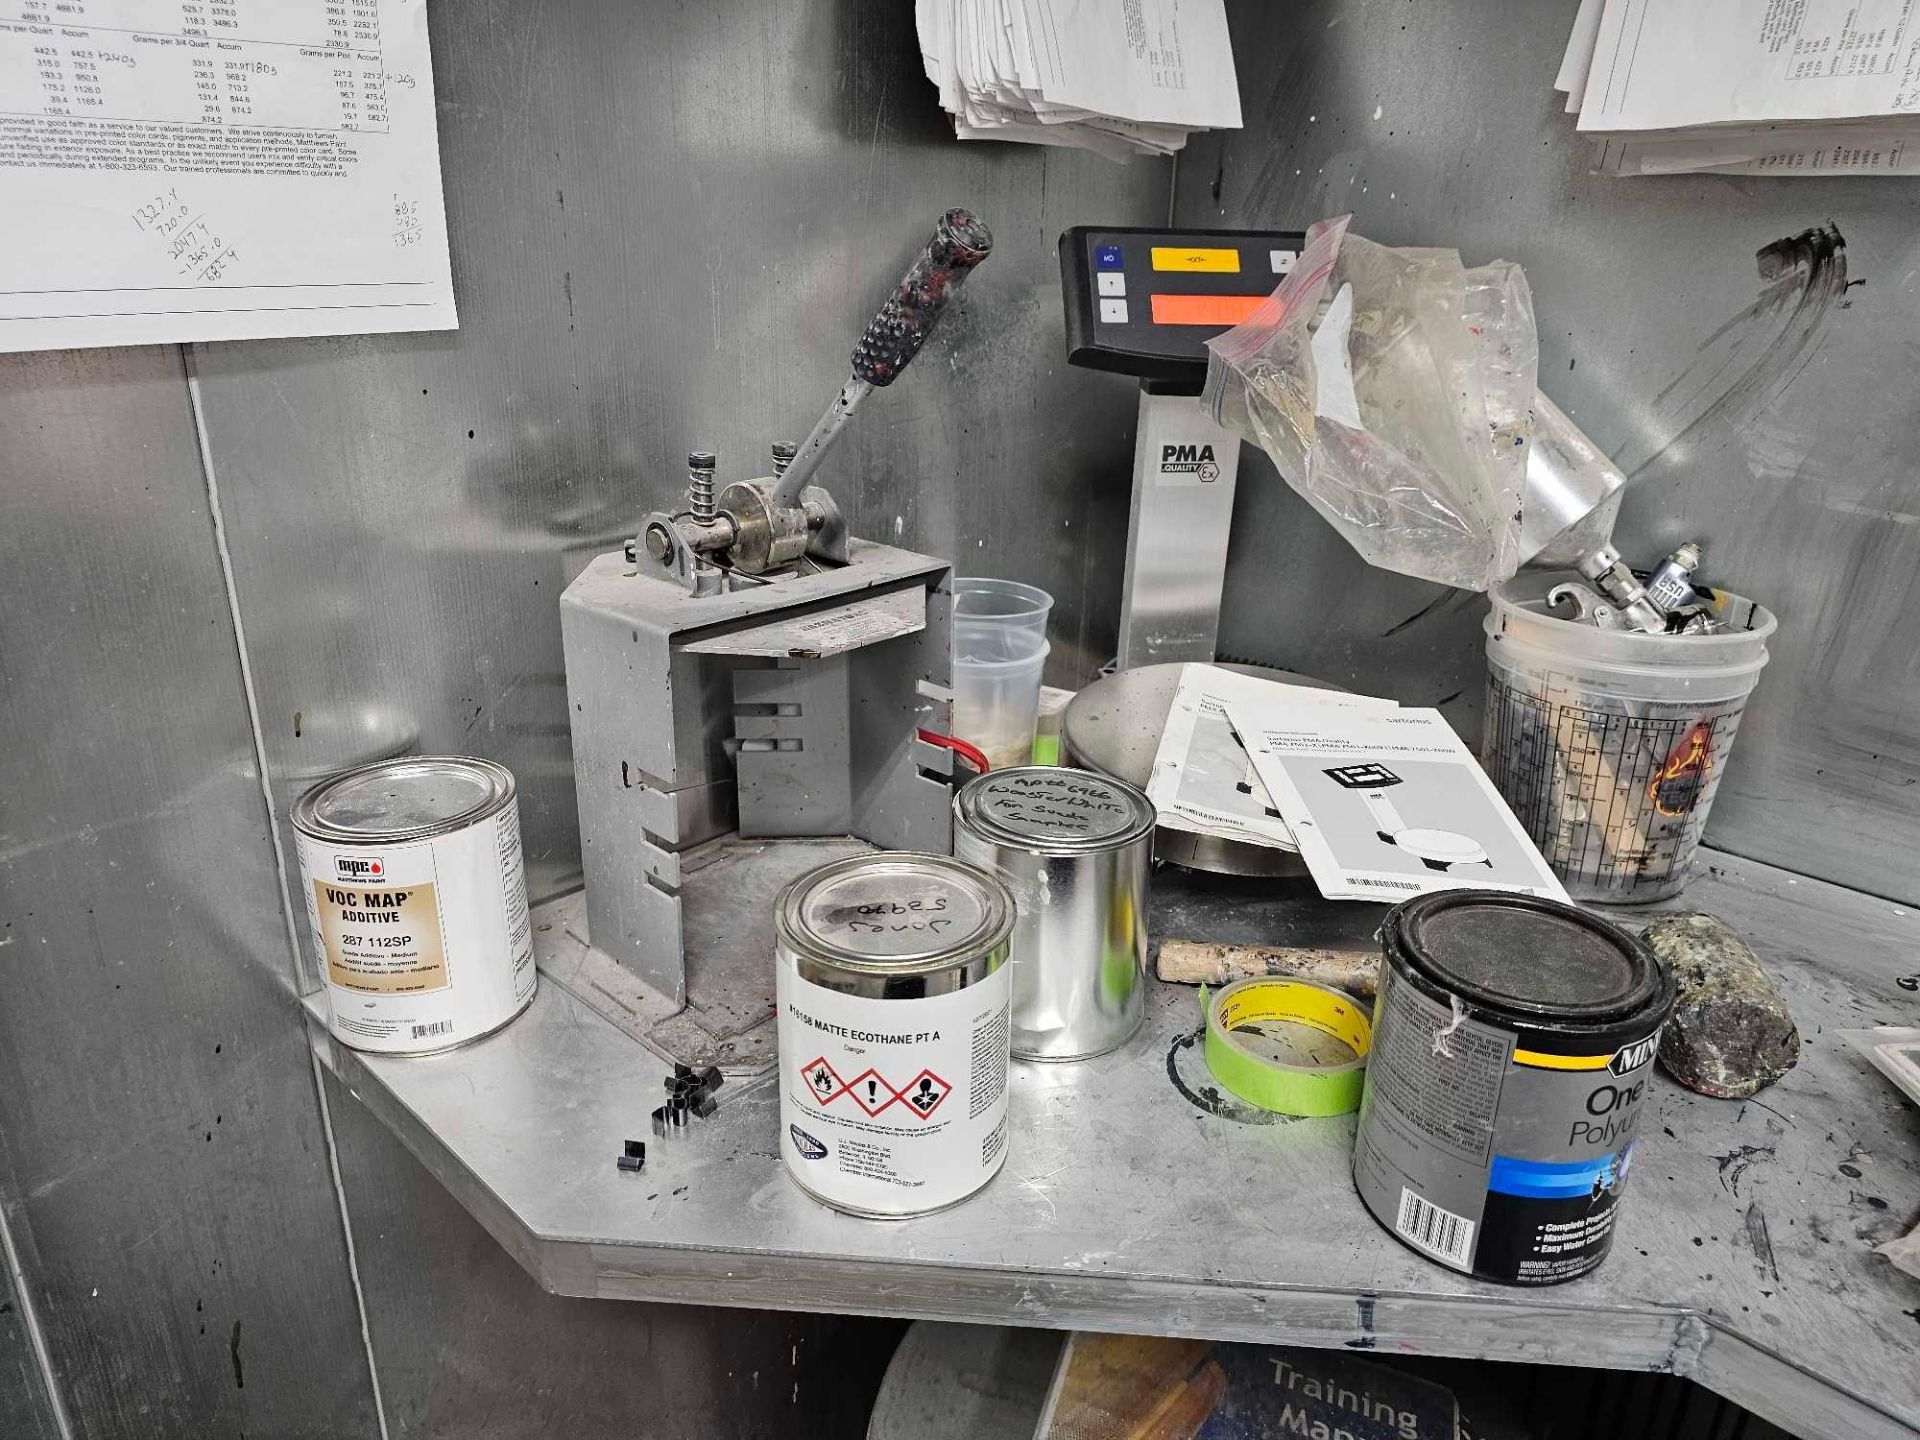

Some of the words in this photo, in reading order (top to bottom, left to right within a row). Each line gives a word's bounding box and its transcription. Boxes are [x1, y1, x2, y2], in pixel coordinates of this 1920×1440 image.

[211, 8, 237, 16] 3378.0
[184, 17, 206, 25] 118.3
[212, 19, 238, 28] 3496.3
[132, 35, 158, 44] Grams
[189, 40, 210, 48] Quart
[217, 42, 242, 50] Accum
[326, 40, 350, 48] 2330.9
[300, 49, 323, 57] Grams
[357, 53, 379, 61] Accum
[192, 59, 213, 67] 331.9
[224, 62, 245, 70] 331.9
[1162, 445, 1215, 462] PMA
[339, 859, 370, 877] mpc
[337, 876, 367, 884] MATTHEWS
[326, 887, 357, 908] VOC
[342, 909, 400, 923] ADDITIVE
[342, 934, 363, 947] 287
[368, 936, 412, 948] 112SP
[391, 951, 418, 959] Medium
[410, 964, 440, 973] mediano
[814, 1019, 848, 1037] MATTE
[850, 1029, 913, 1044] ECOTHANE
[916, 1032, 930, 1043] PT
[932, 1030, 941, 1041] A
[844, 1043, 866, 1055] Danger
[1586, 1079, 1645, 1116] One
[851, 1147, 879, 1156] Washington
[862, 1171, 892, 1183] International
[1545, 1220, 1585, 1232] Complete
[1543, 1231, 1585, 1243] Maximum
[1540, 1244, 1562, 1254] Easy
[1563, 1239, 1586, 1251] Water
[1269, 1357, 1418, 1439] Training
